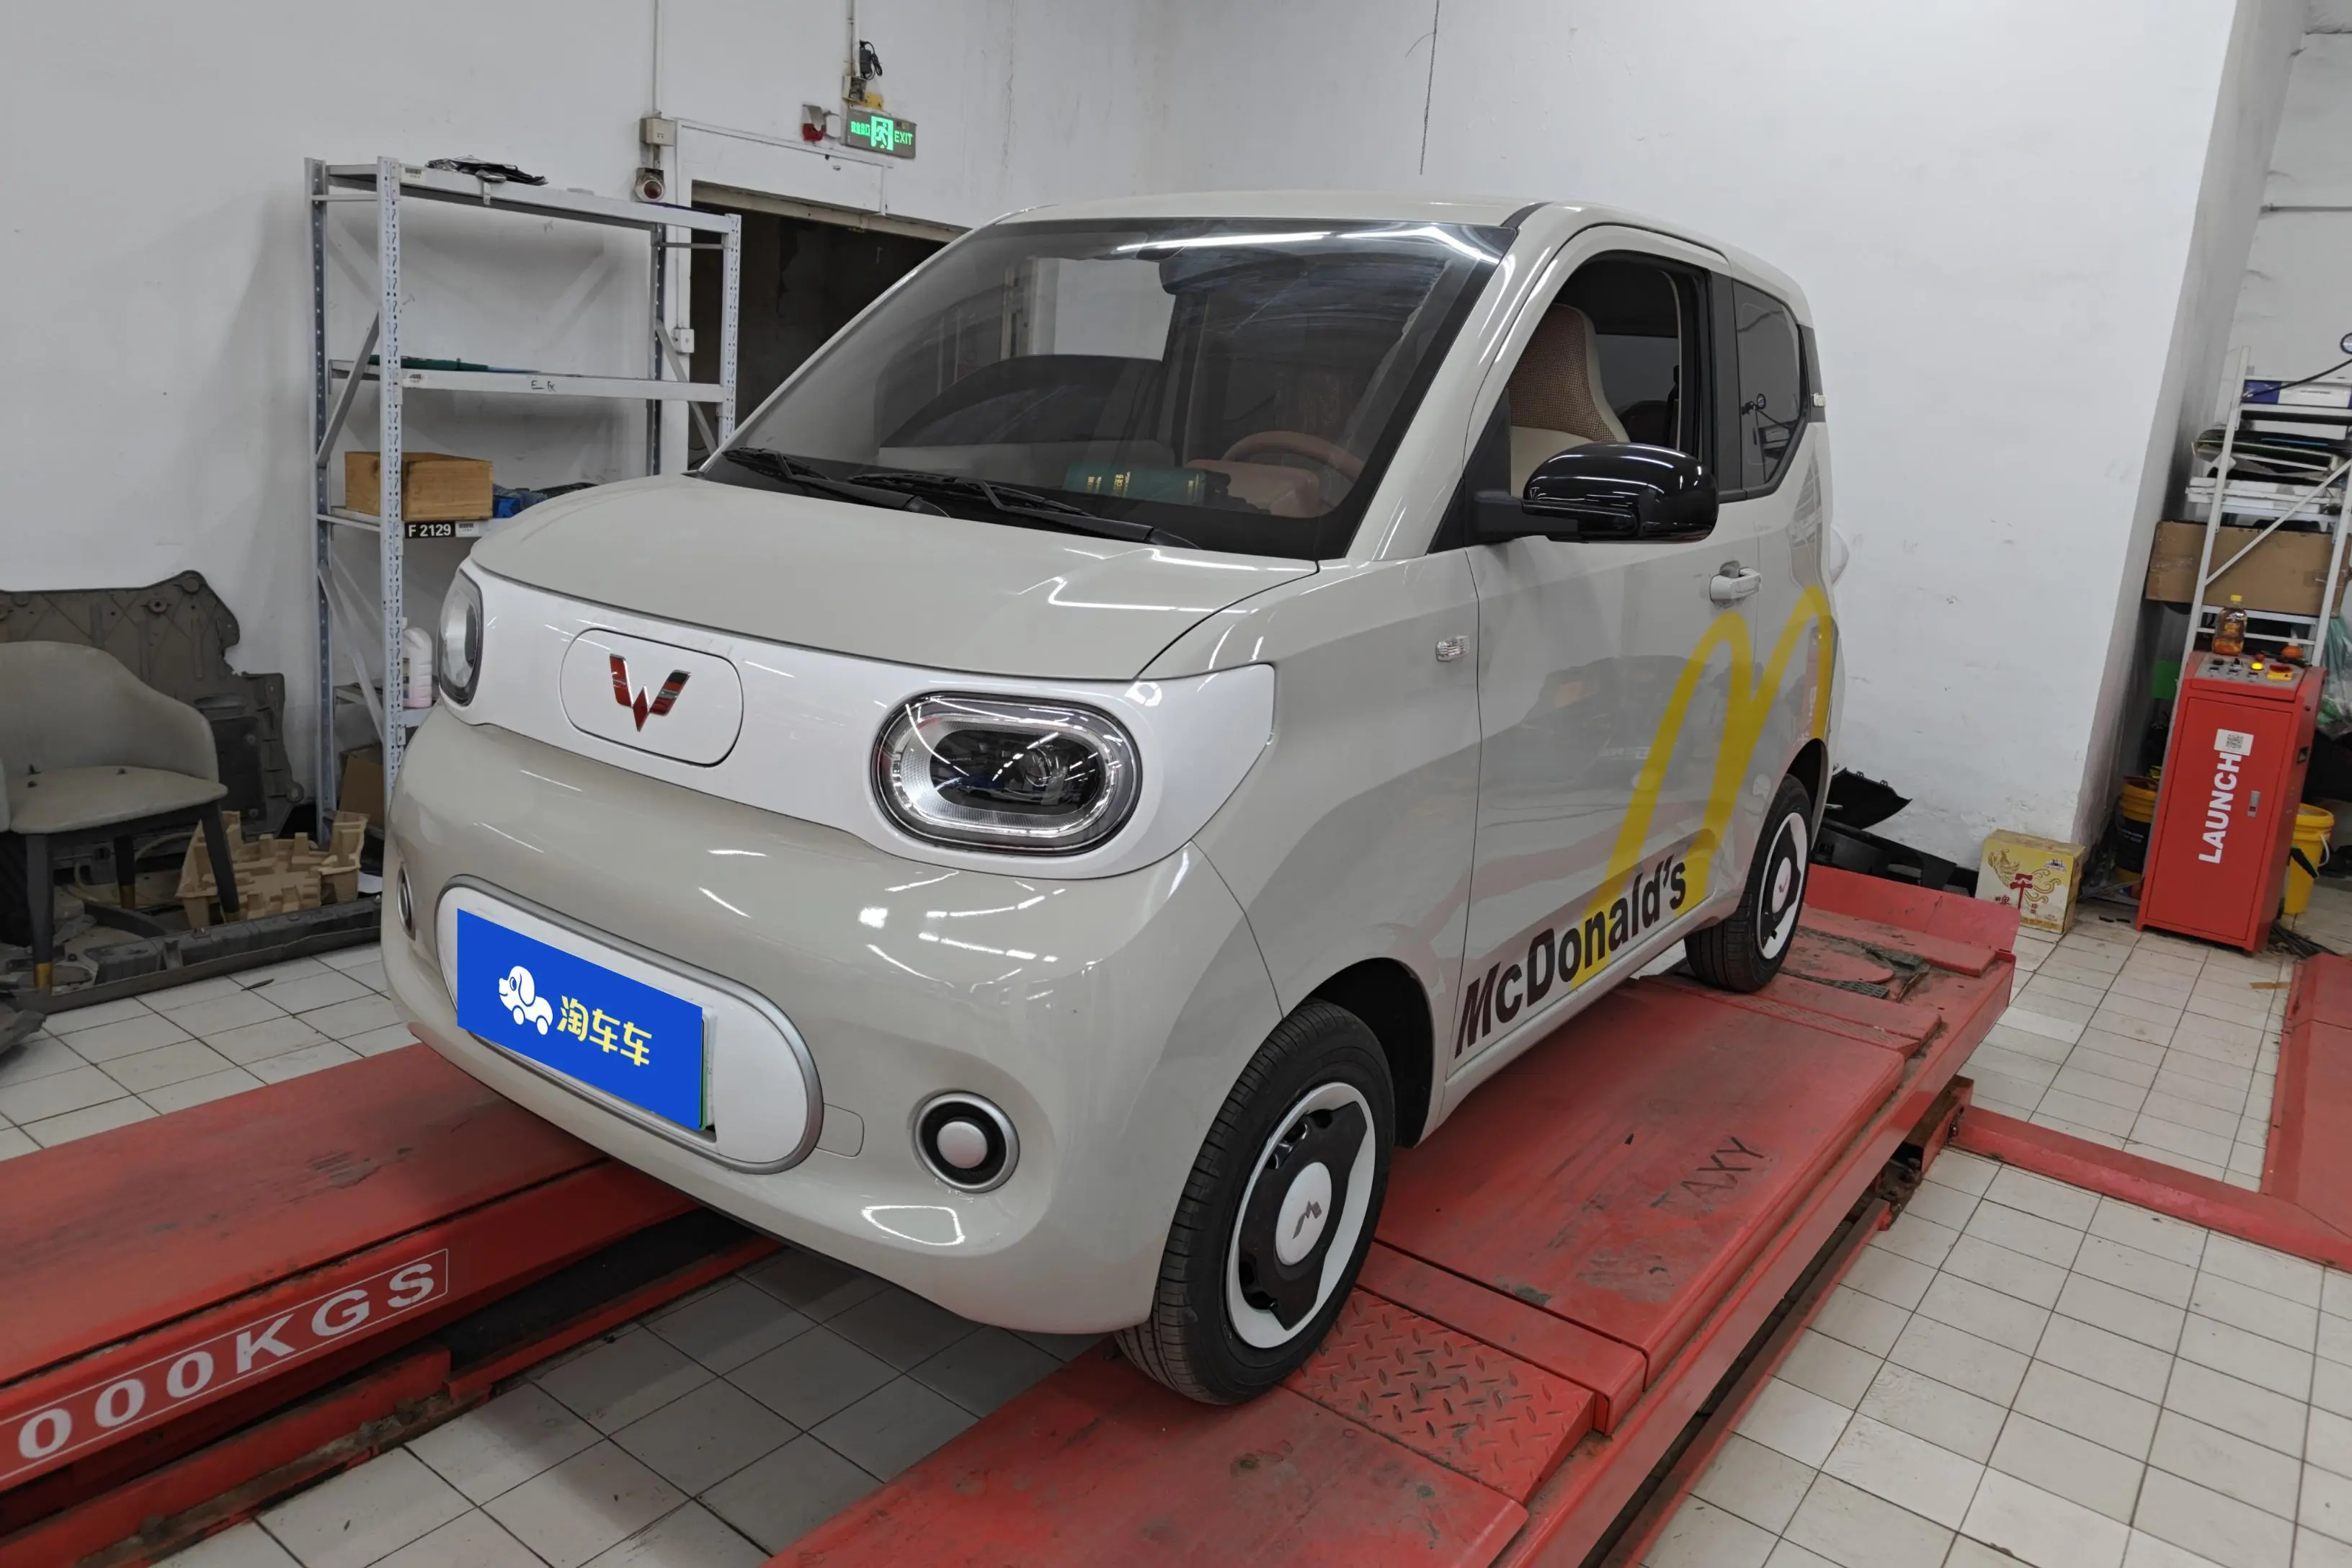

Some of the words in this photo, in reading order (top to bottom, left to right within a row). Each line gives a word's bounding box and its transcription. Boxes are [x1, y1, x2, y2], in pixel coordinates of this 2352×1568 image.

[894, 130, 913, 146] EXIT
[409, 525, 416, 537] F
[419, 524, 451, 537] 2129
[2199, 752, 2242, 864] LAUNCH
[1454, 853, 1687, 1060] McDonald's
